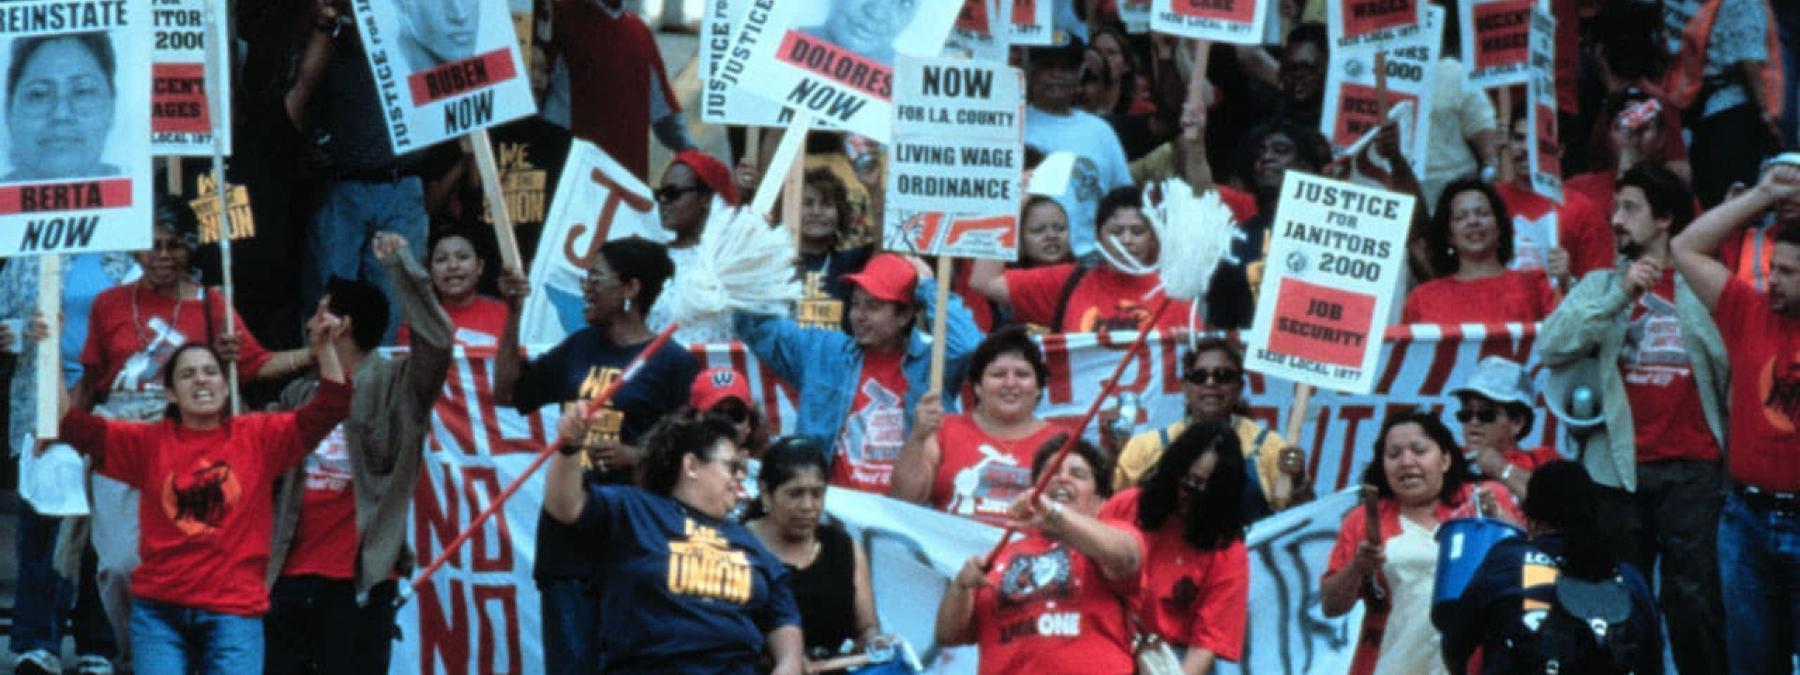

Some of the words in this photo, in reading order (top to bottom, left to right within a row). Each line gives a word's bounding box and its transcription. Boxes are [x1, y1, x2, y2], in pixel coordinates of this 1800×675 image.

[424, 57, 488, 100] RUBEN
[789, 38, 893, 98] DOLORES
[922, 65, 993, 99] NOW
[372, 49, 411, 147] JUSTICE
[444, 90, 495, 136] NOW
[787, 76, 867, 122] NOW
[897, 104, 925, 122] FOR
[928, 108, 951, 123] L.A.
[956, 108, 1015, 127] COUNTY
[896, 143, 956, 166] LIVING
[961, 147, 1013, 168] WAGE
[20, 182, 104, 212] BERTA
[897, 174, 1010, 200] ORDINANCE
[1294, 180, 1400, 220] JUSTICE
[19, 216, 100, 251] NOW
[1325, 211, 1359, 229] FOR
[1283, 221, 1391, 259] JANITORS
[1318, 253, 1381, 282] 2000
[1307, 299, 1344, 322] JOB
[1278, 317, 1364, 348] SECURITY
[1256, 348, 1287, 365] SEIU
[1289, 354, 1329, 375] LOCAL
[1333, 365, 1362, 381] 1877
[412, 462, 515, 573] NO
[417, 576, 523, 675] NO
[1037, 611, 1082, 637] ONE
